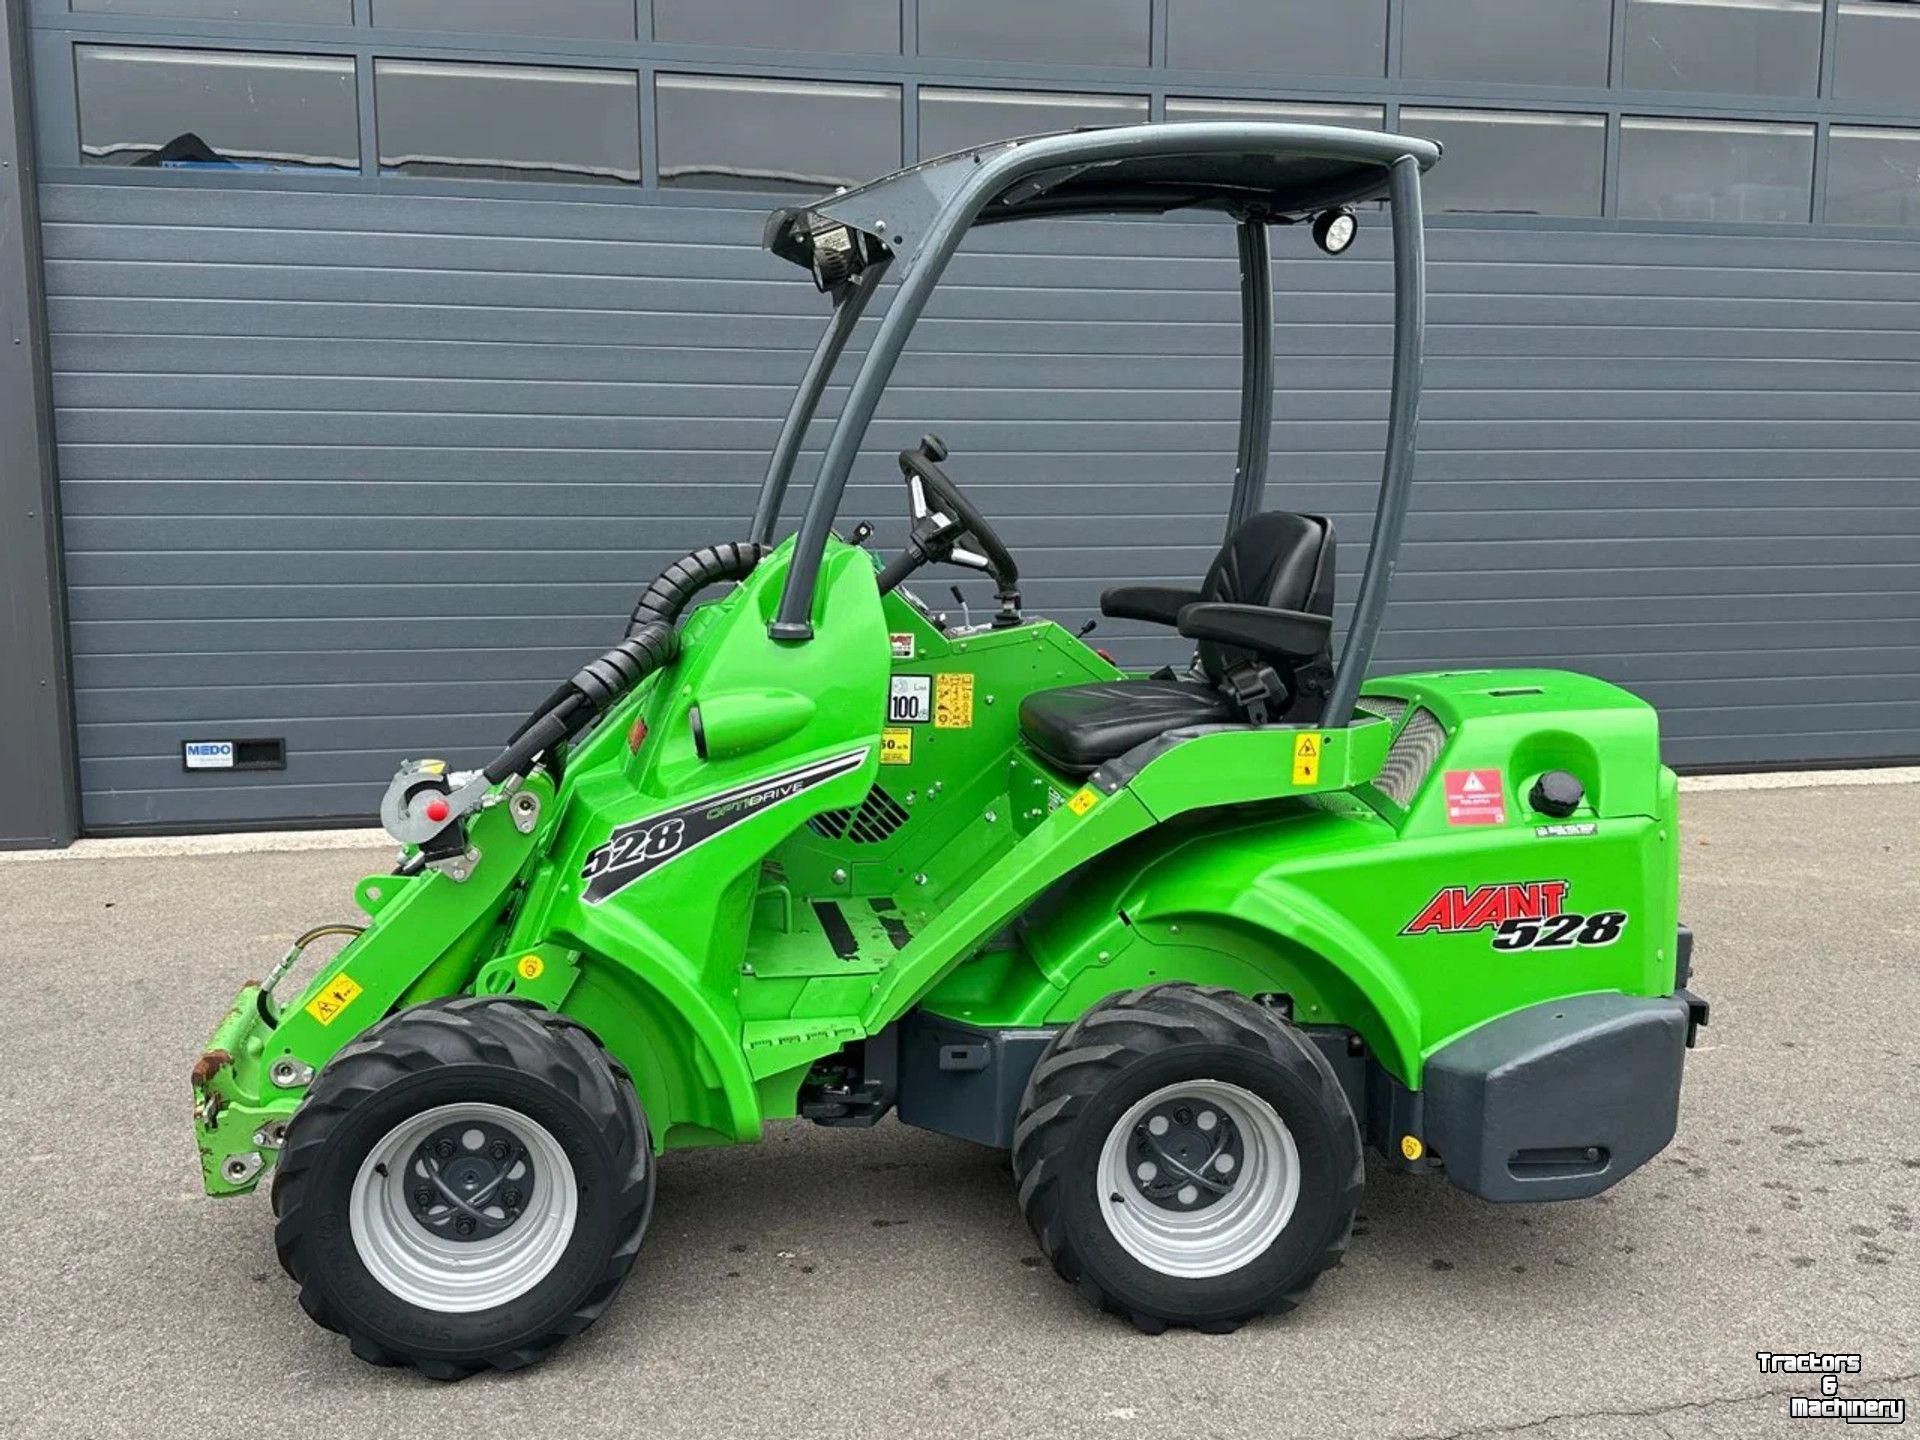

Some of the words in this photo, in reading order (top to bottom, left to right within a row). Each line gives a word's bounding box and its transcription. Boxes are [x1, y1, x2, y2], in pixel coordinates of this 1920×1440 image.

[892, 695, 919, 718] 100
[187, 744, 231, 756] MEDO
[706, 780, 804, 821] OPTIDRIVE
[580, 818, 685, 879] 528
[1398, 879, 1570, 936] AVANT
[1492, 911, 1628, 952] 528
